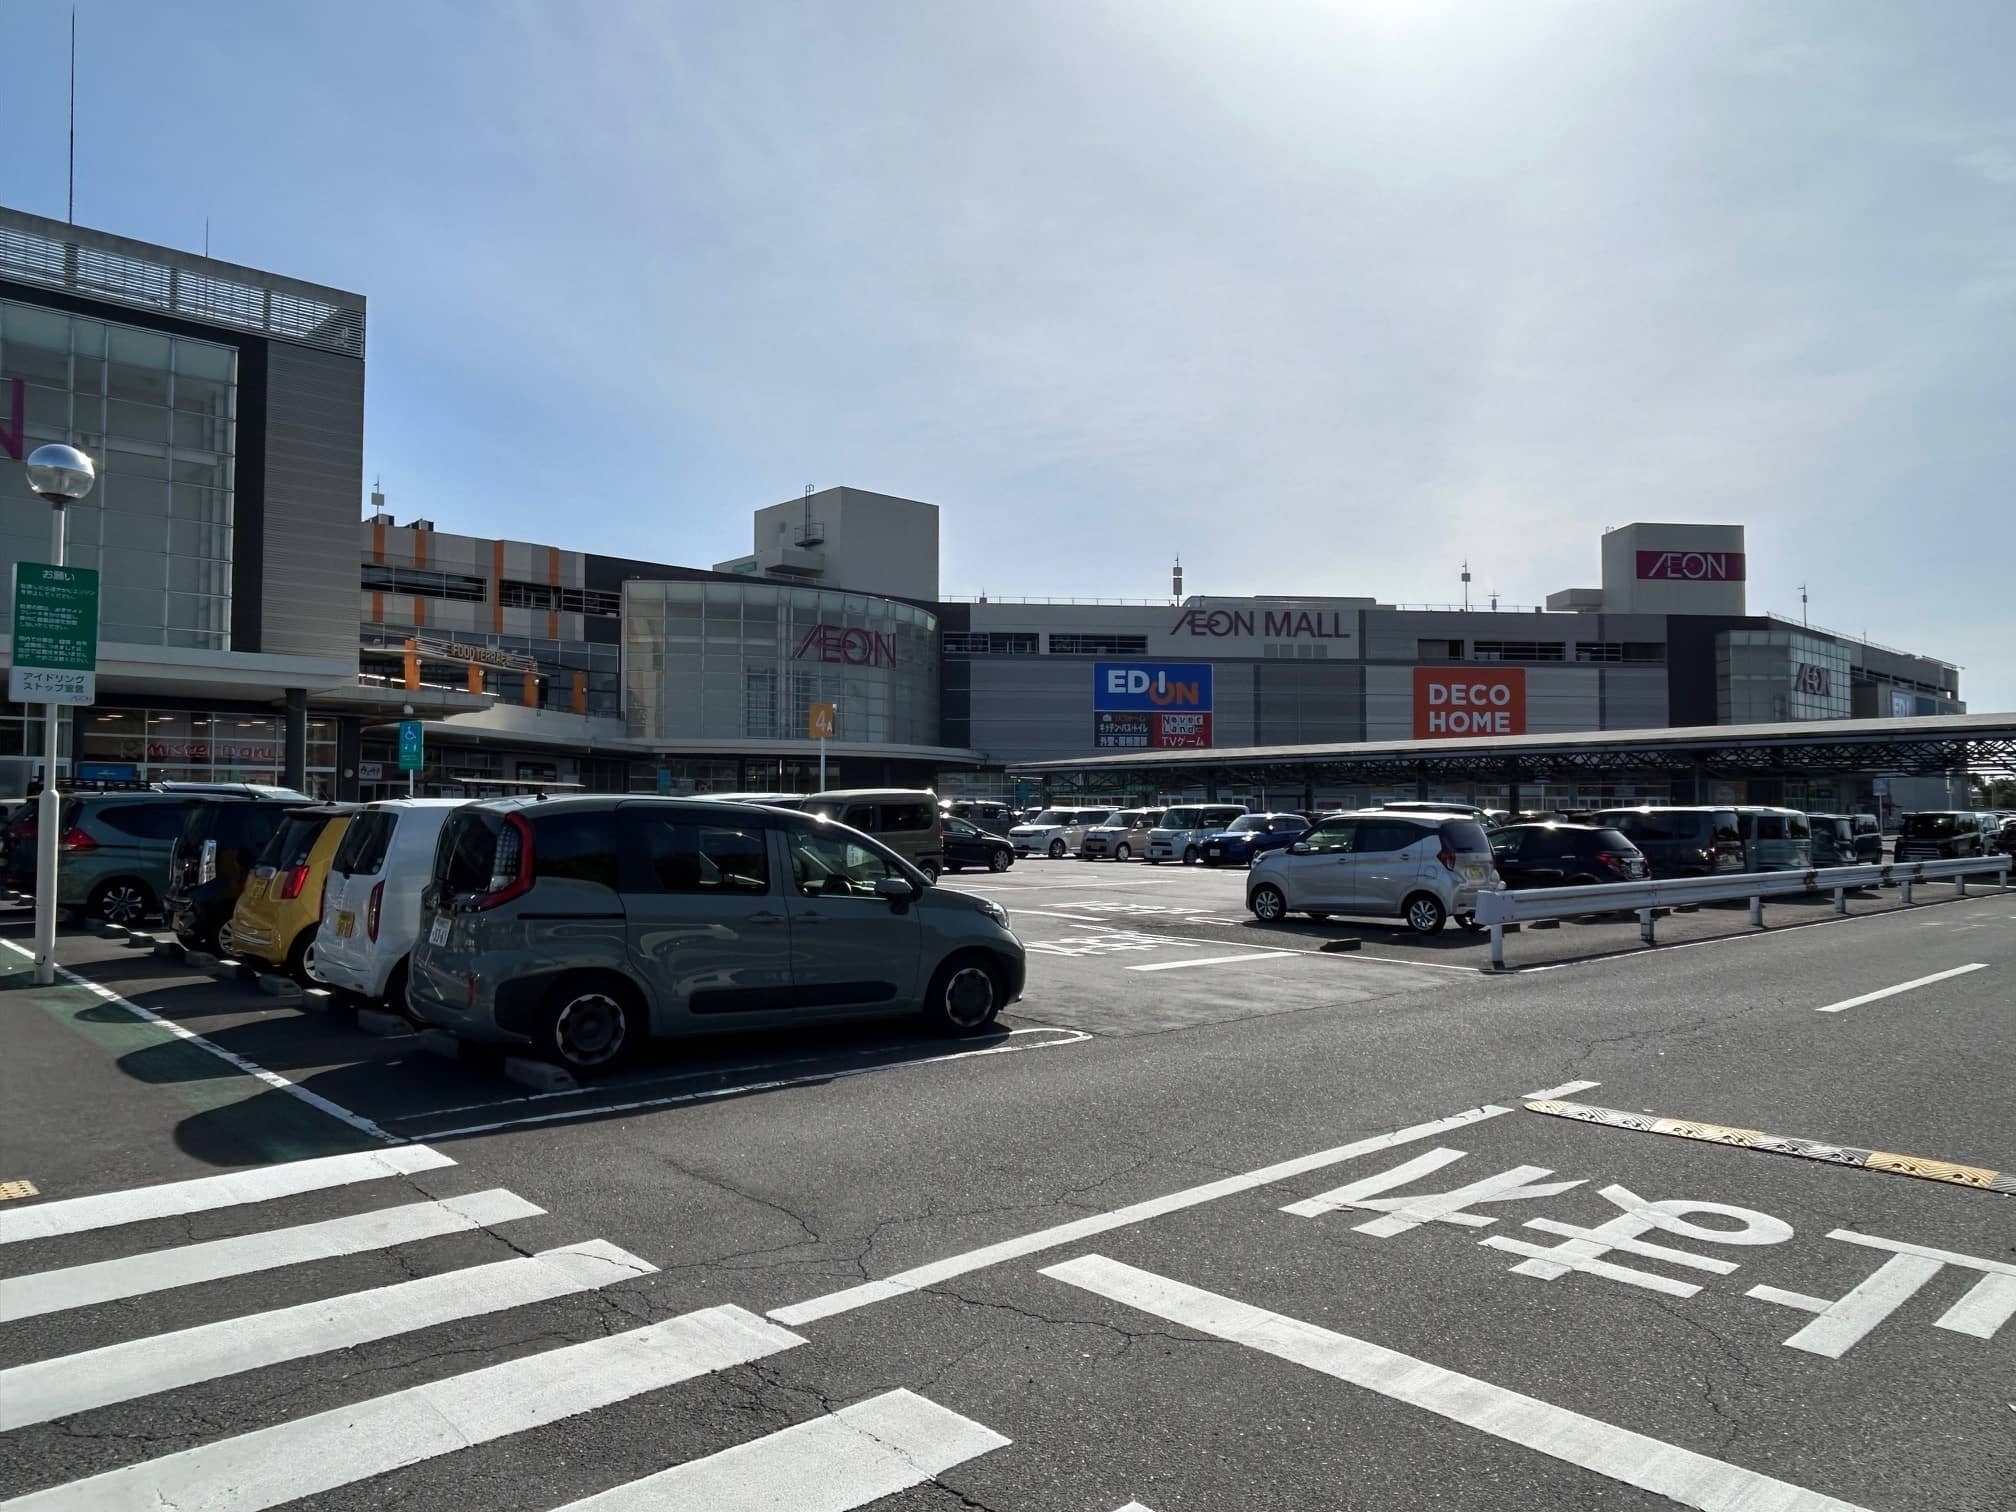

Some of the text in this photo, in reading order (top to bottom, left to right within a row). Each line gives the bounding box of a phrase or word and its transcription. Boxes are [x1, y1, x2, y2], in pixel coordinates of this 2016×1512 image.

[1648, 552, 1726, 579] AEON
[1169, 610, 1350, 638] AEON MALL
[453, 643, 475, 658] FOOD
[793, 624, 896, 671] AEON
[24, 672, 85, 684] アイドリング
[1107, 670, 1199, 705] EDION
[1429, 684, 1511, 706] DECO
[1429, 711, 1511, 733] HOME
[1162, 736, 1205, 747] TVゲーム
